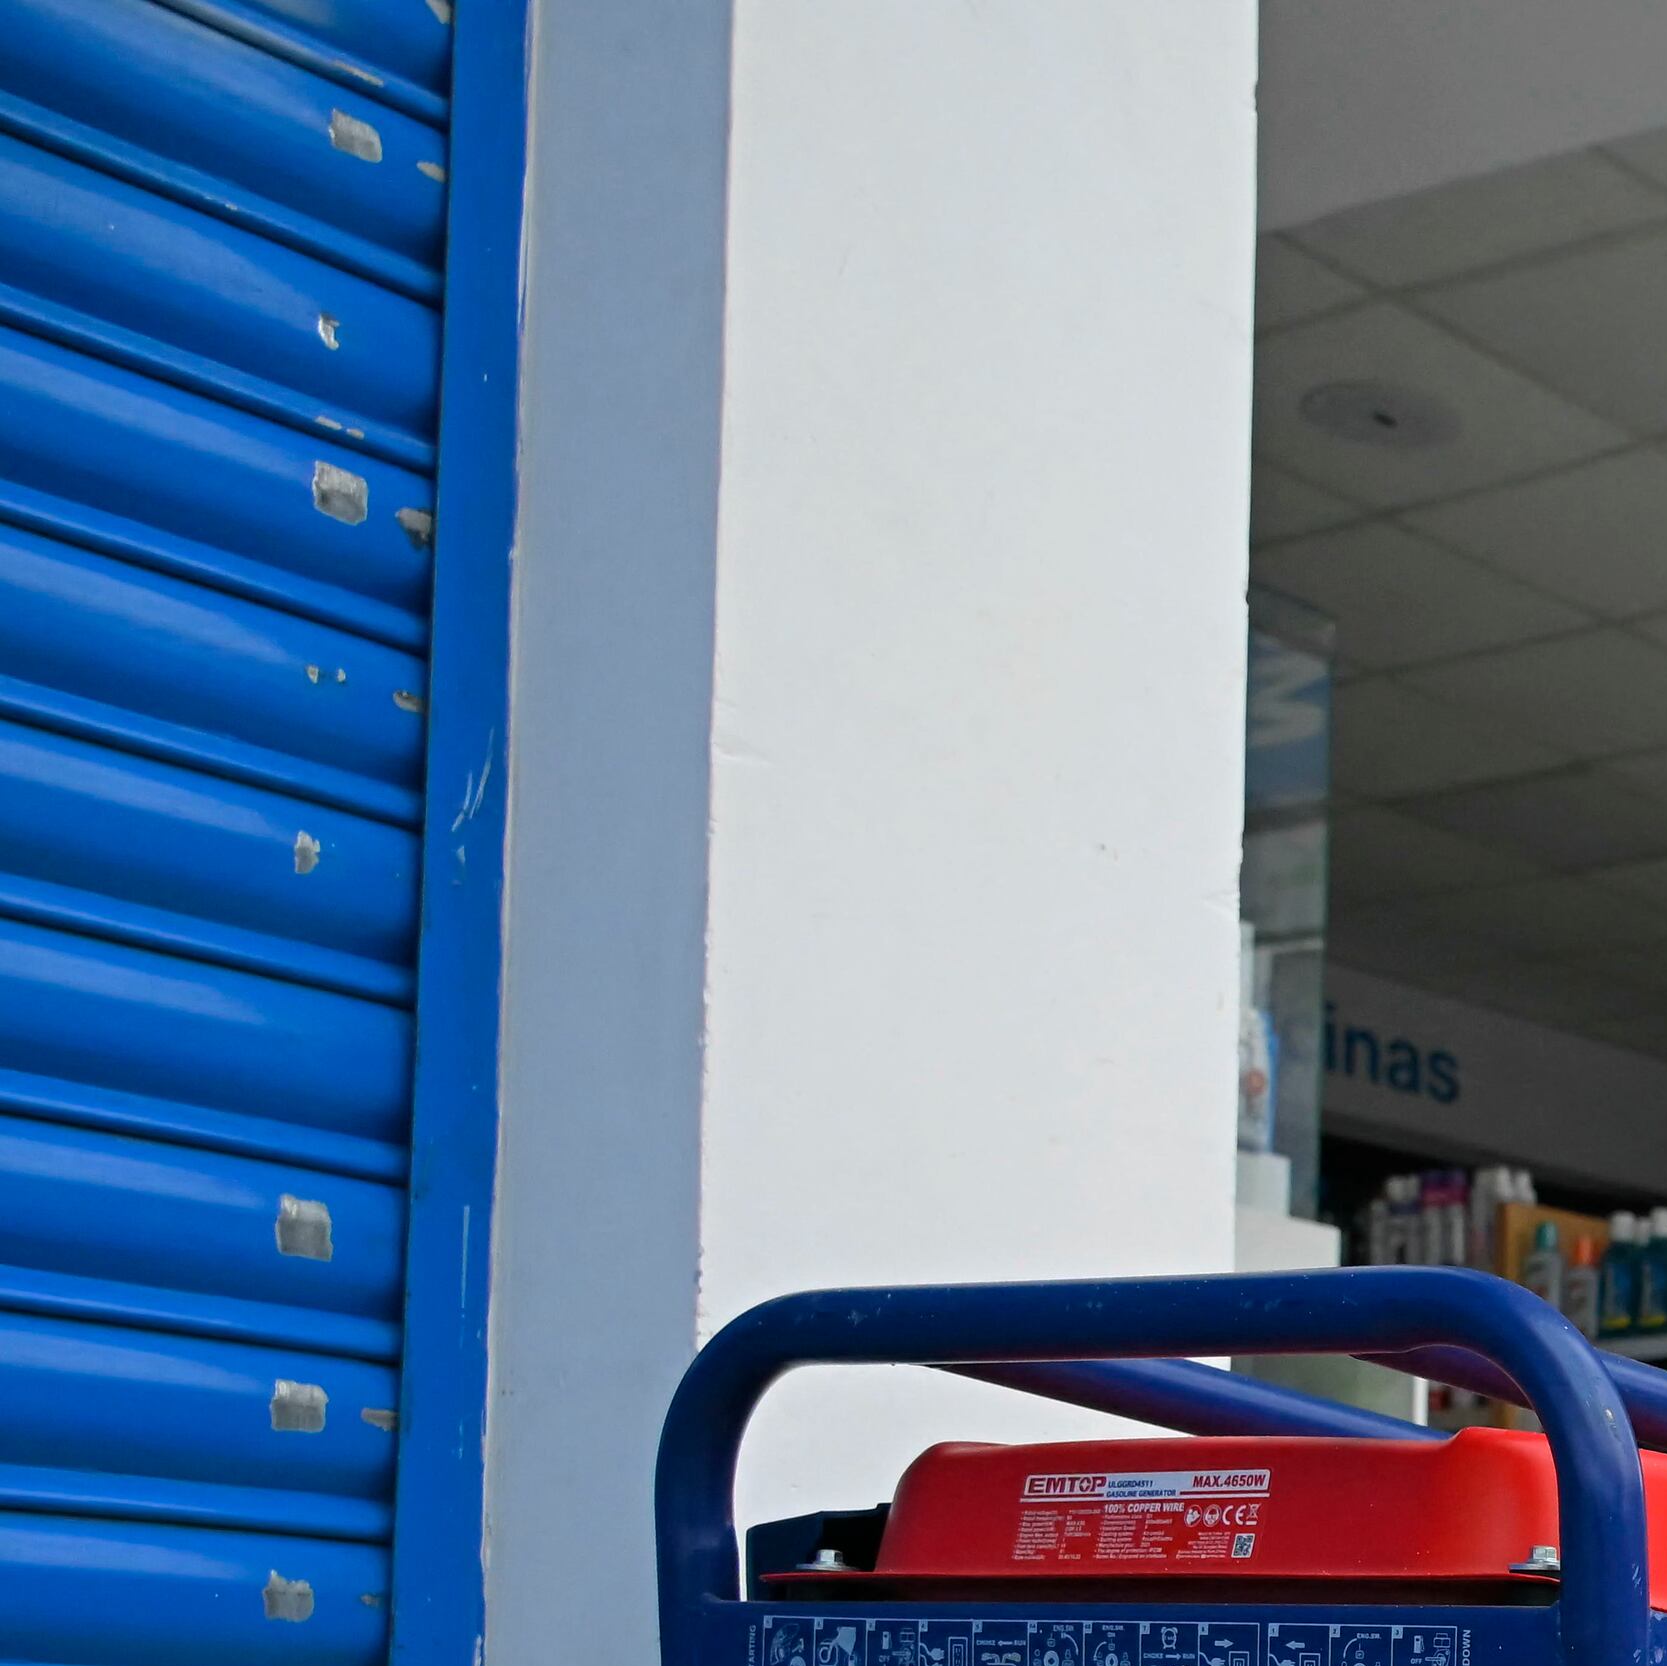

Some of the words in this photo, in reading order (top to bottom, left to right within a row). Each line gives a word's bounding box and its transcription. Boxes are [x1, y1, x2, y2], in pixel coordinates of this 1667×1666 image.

[1028, 1475, 1107, 1494] EMTOP
[1192, 1474, 1266, 1488] MAX.4650W
[1106, 1490, 1138, 1498] GASOLINE
[1138, 1489, 1176, 1497] GENERATOR
[1104, 1503, 1125, 1514] 100%
[1127, 1502, 1161, 1513] COPPER
[1162, 1502, 1185, 1512] WIRE
[1410, 1657, 1423, 1665] OFF
